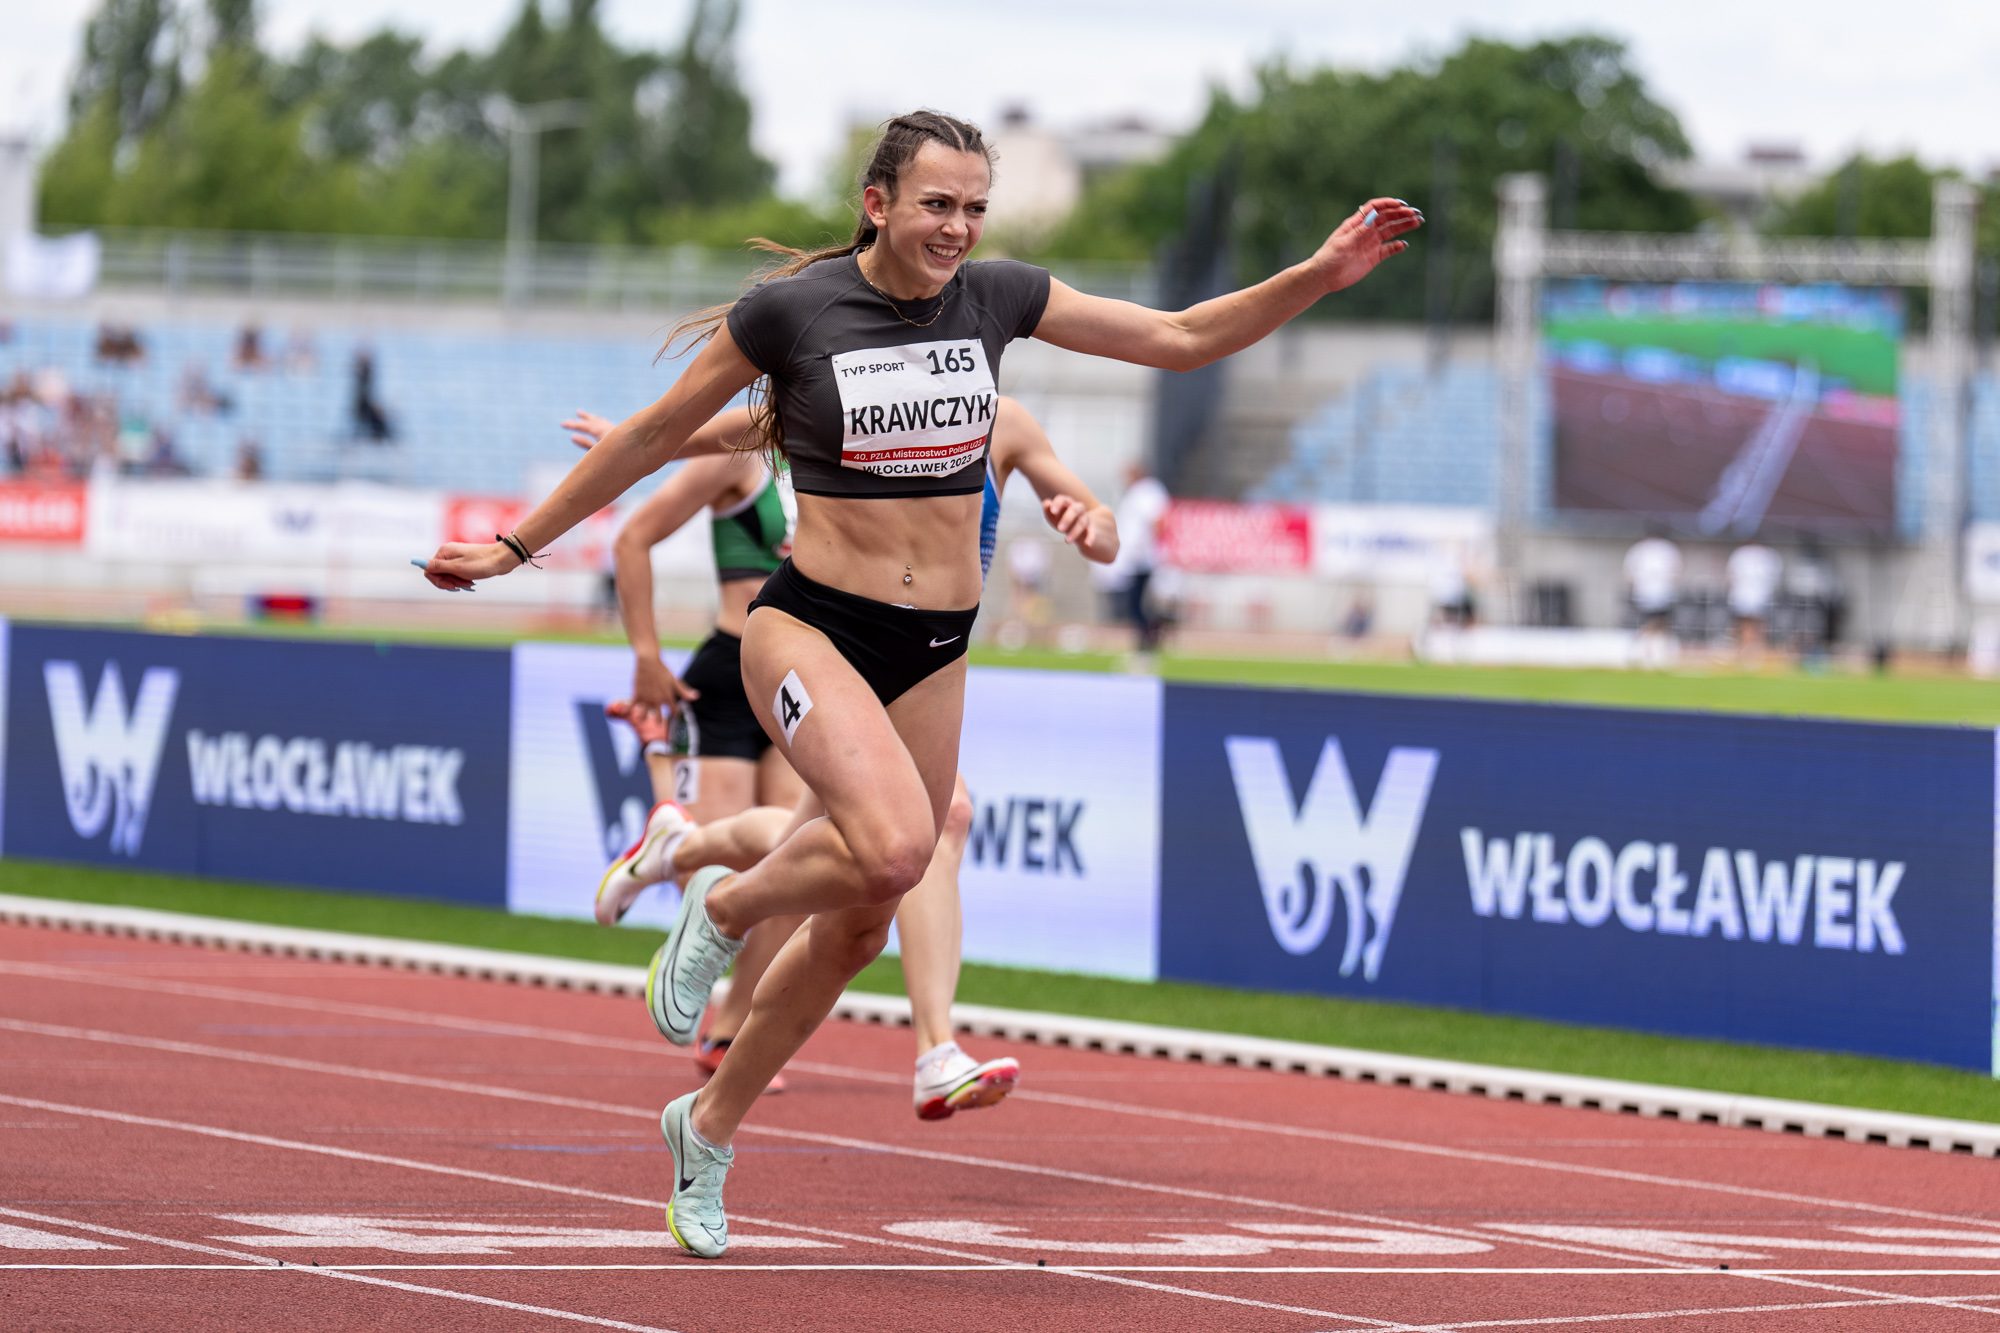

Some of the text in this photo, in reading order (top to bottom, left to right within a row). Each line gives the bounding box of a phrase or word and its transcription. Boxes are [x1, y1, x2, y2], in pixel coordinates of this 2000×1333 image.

[841, 362, 905, 378] TVP SPORT
[926, 347, 975, 375] 165
[851, 394, 991, 435] KRAWCZYK
[853, 453, 868, 461] 40.
[870, 452, 890, 460] PZLA
[892, 449, 947, 459] Mistrzostwa
[948, 443, 969, 455] Polski
[862, 454, 972, 475] WŁOCŁAWEK 2023
[781, 685, 801, 731] 4
[187, 730, 463, 824] WŁOCŁAWEK
[676, 765, 691, 799] 2
[1460, 827, 1907, 954] WŁOCŁAWEK
